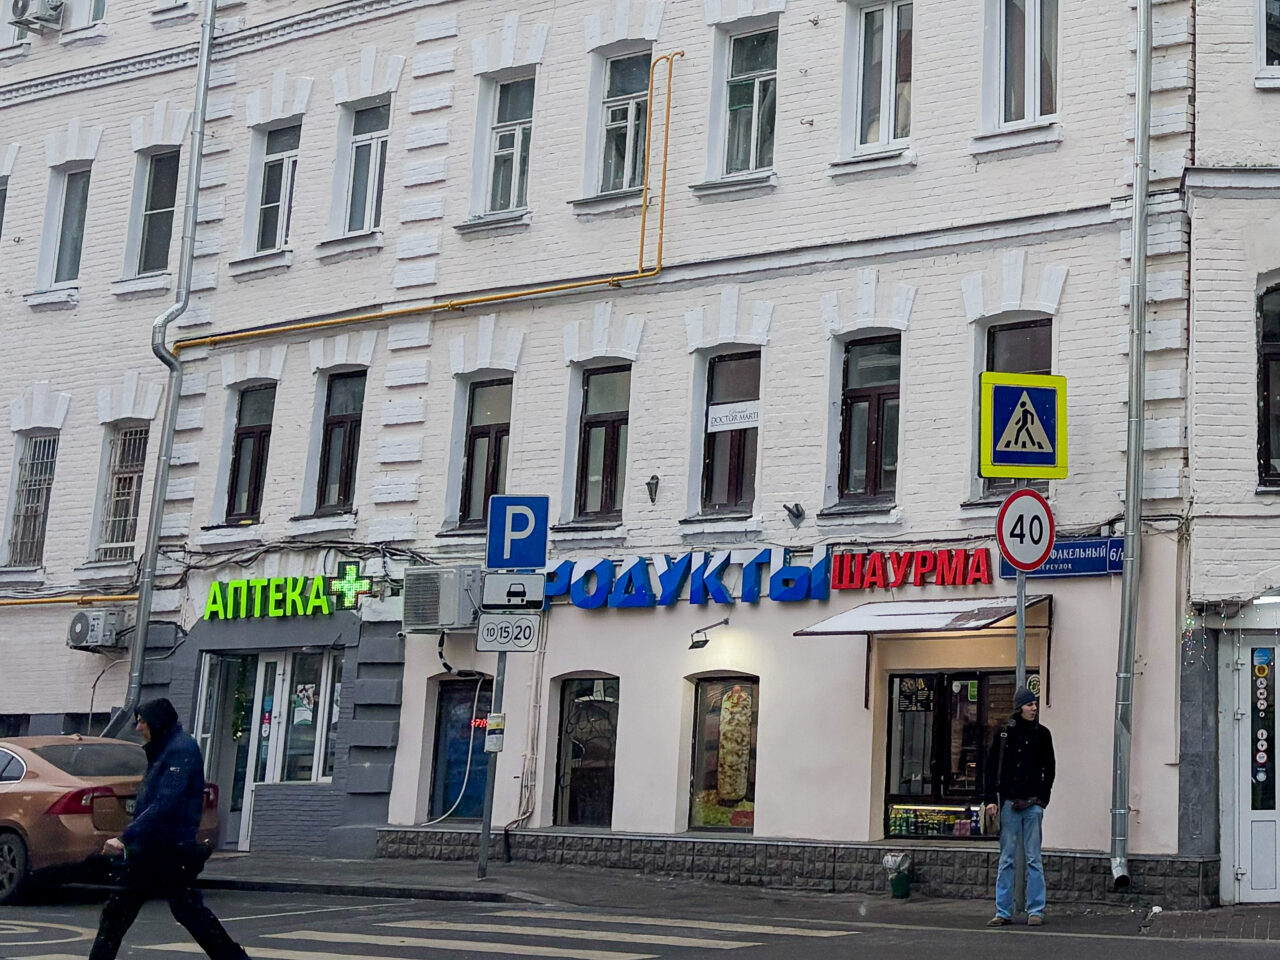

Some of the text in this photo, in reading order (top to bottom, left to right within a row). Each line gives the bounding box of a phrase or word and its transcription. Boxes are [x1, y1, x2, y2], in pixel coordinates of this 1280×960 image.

[711, 414, 738, 425] DOCTOR
[739, 411, 759, 421] MARTI
[503, 505, 536, 559] P
[1009, 513, 1044, 546] 40
[831, 548, 993, 590] ШАУРМА
[1039, 562, 1073, 571] ЕРЕУЛОК
[1050, 545, 1106, 560] ФАКЕЛЬНЫЙ
[541, 543, 832, 610] РОДУКТЫ
[203, 575, 331, 621] АПТЕКА
[485, 625, 533, 640] 10 15 20
